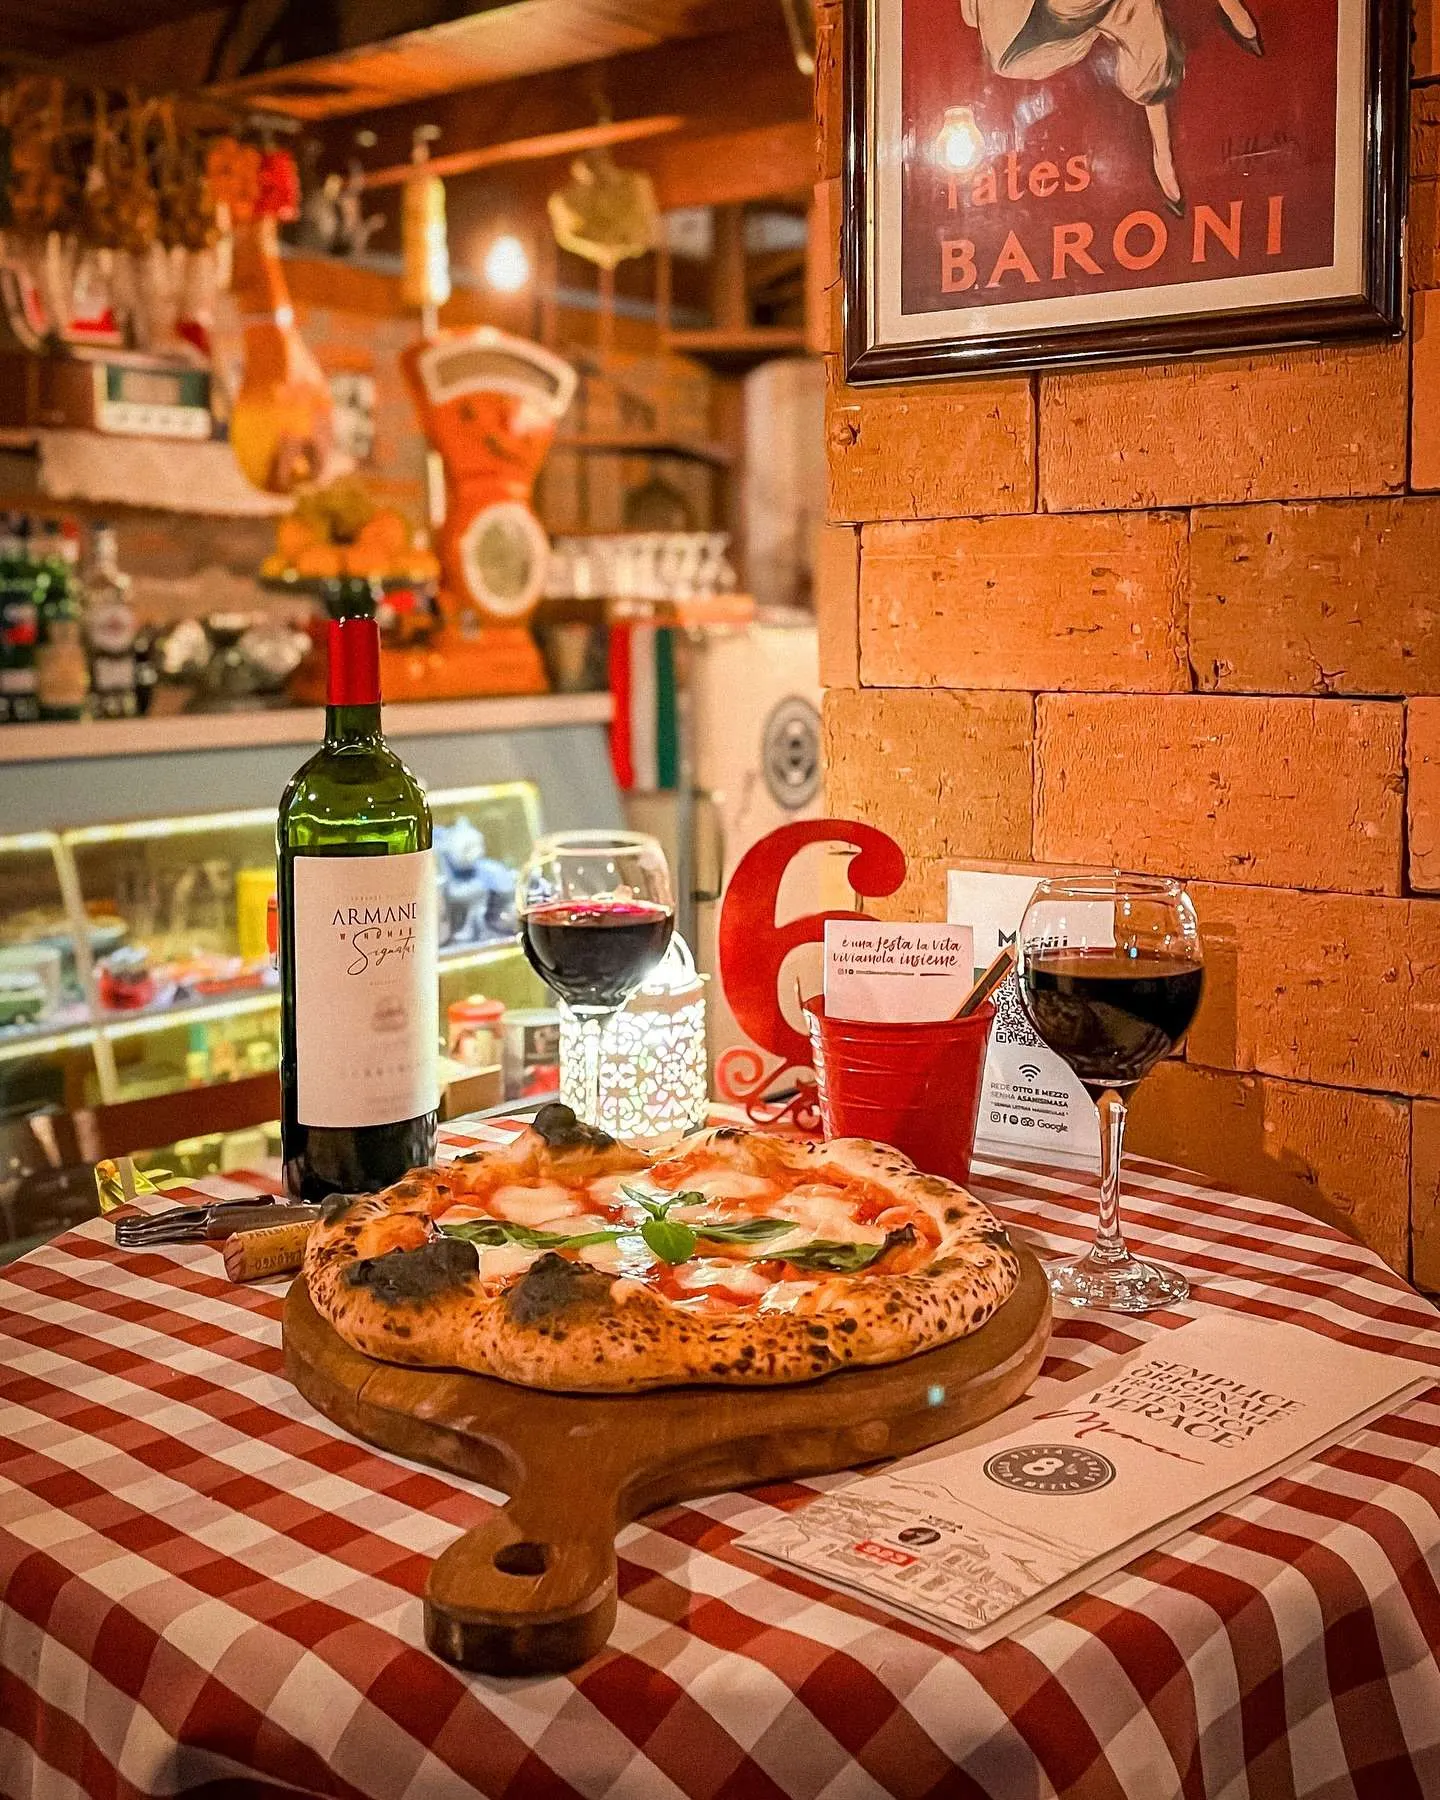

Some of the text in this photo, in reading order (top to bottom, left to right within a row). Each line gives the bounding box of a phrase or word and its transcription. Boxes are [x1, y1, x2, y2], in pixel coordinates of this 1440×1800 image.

[941, 195, 1284, 293] BARONI
[833, 951, 958, 967] viviamola insieme
[851, 939, 873, 949] una
[876, 936, 913, 952] festa
[916, 938, 929, 950] la
[1012, 1085, 1033, 1094] OTTO
[1041, 1089, 1069, 1099] MEZZO
[1037, 1119, 1069, 1133] Google
[1103, 1384, 1255, 1437] AUTENTICA
[1119, 1376, 1275, 1426] TRADIZIONALE
[1131, 1368, 1290, 1421] ORIGINALE
[1149, 1360, 1306, 1412] SEMPLICE
[1089, 1392, 1246, 1449] VERACE
